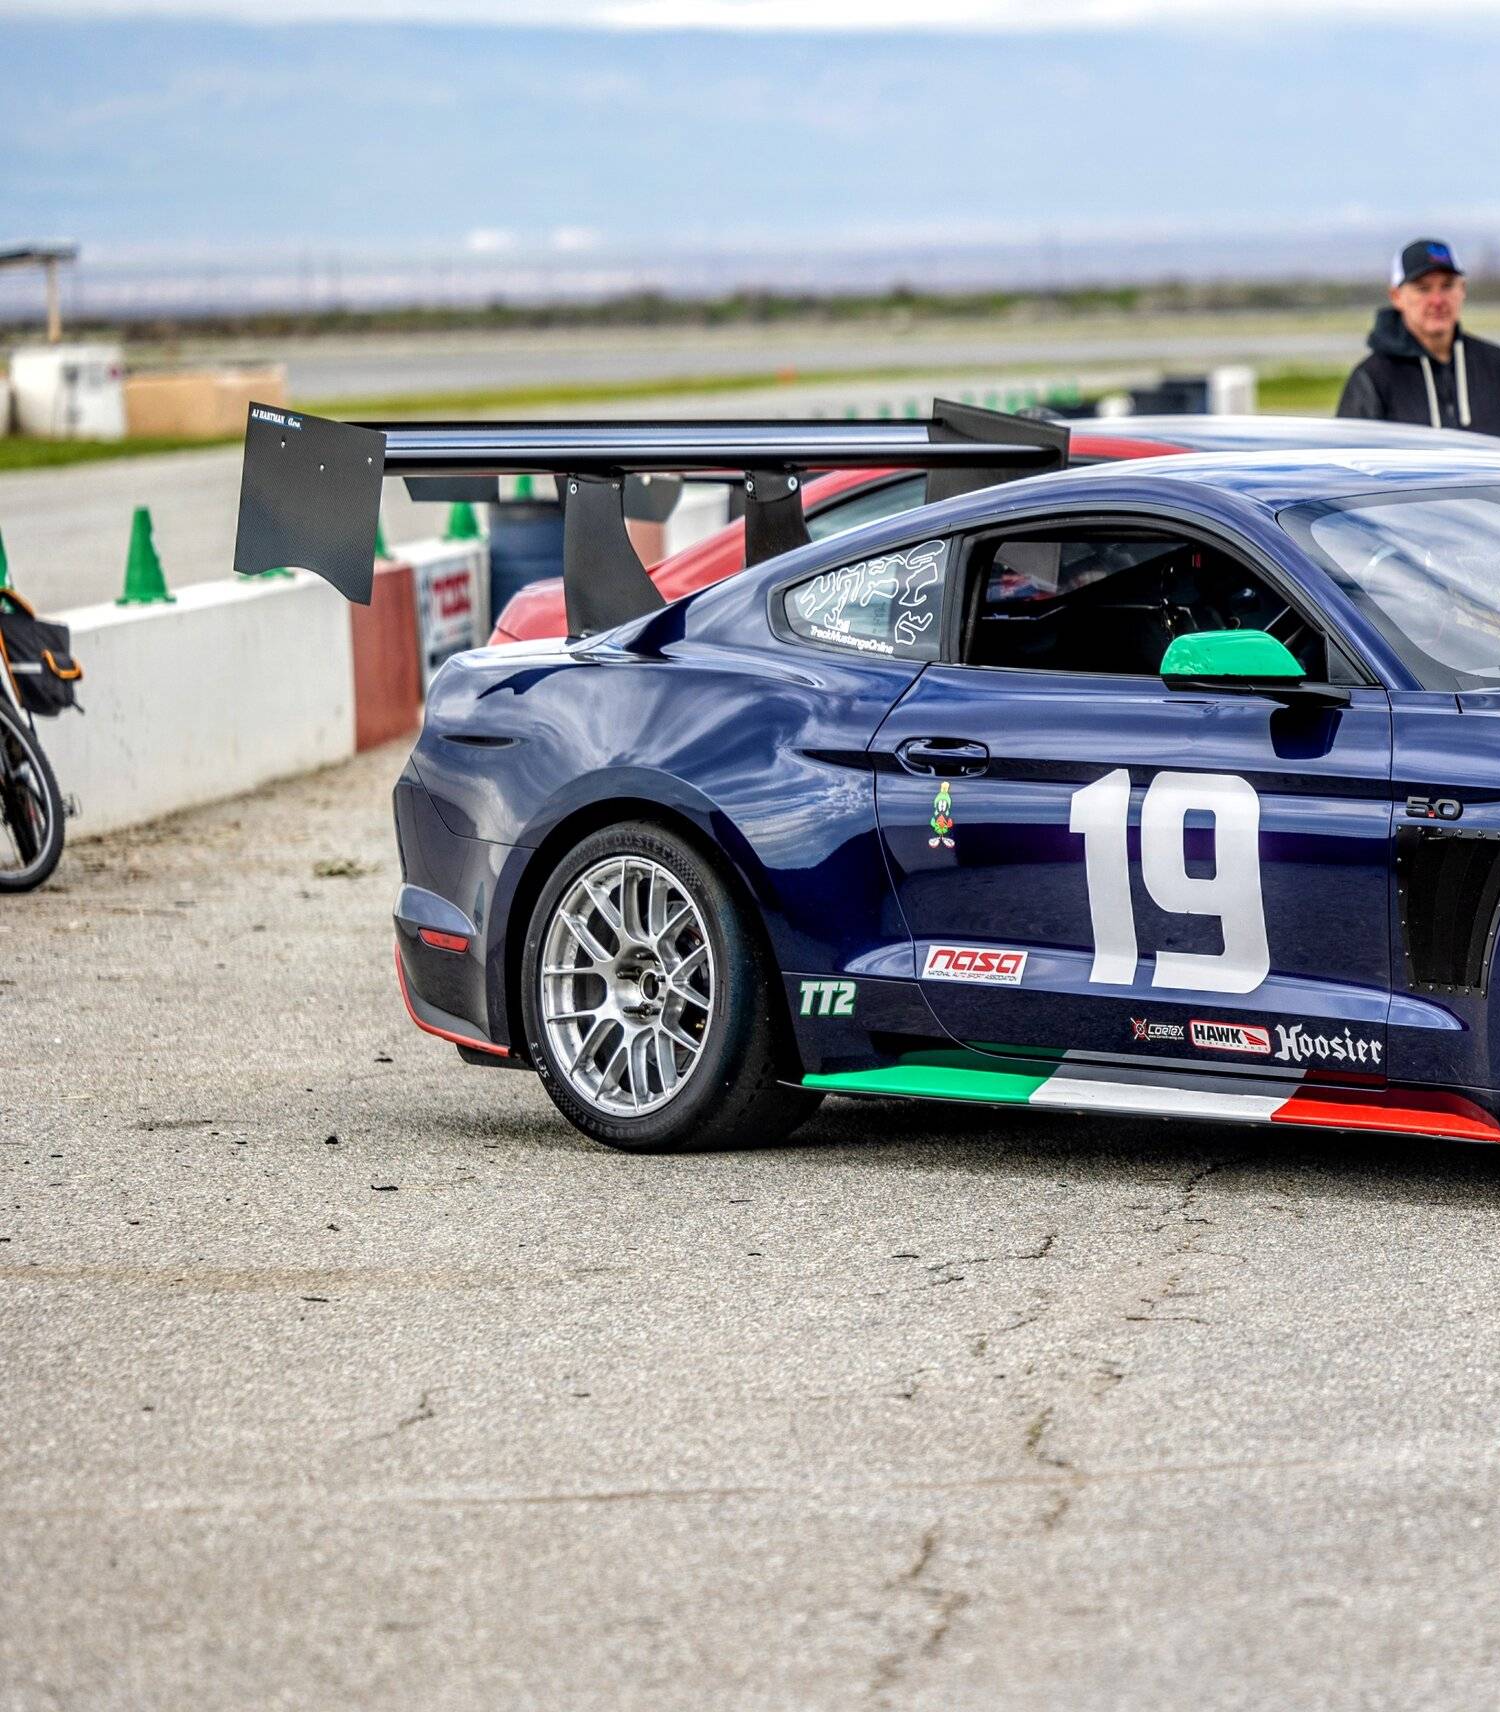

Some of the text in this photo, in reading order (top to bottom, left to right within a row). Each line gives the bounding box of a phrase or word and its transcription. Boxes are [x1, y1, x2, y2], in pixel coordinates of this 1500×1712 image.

[259, 410, 285, 424] HARTMAN
[1405, 796, 1463, 821] 5.0
[1069, 768, 1270, 994] 19
[800, 981, 857, 1016] TT2
[1193, 1024, 1243, 1045] HAWK
[1275, 1023, 1383, 1065] Hoosier
